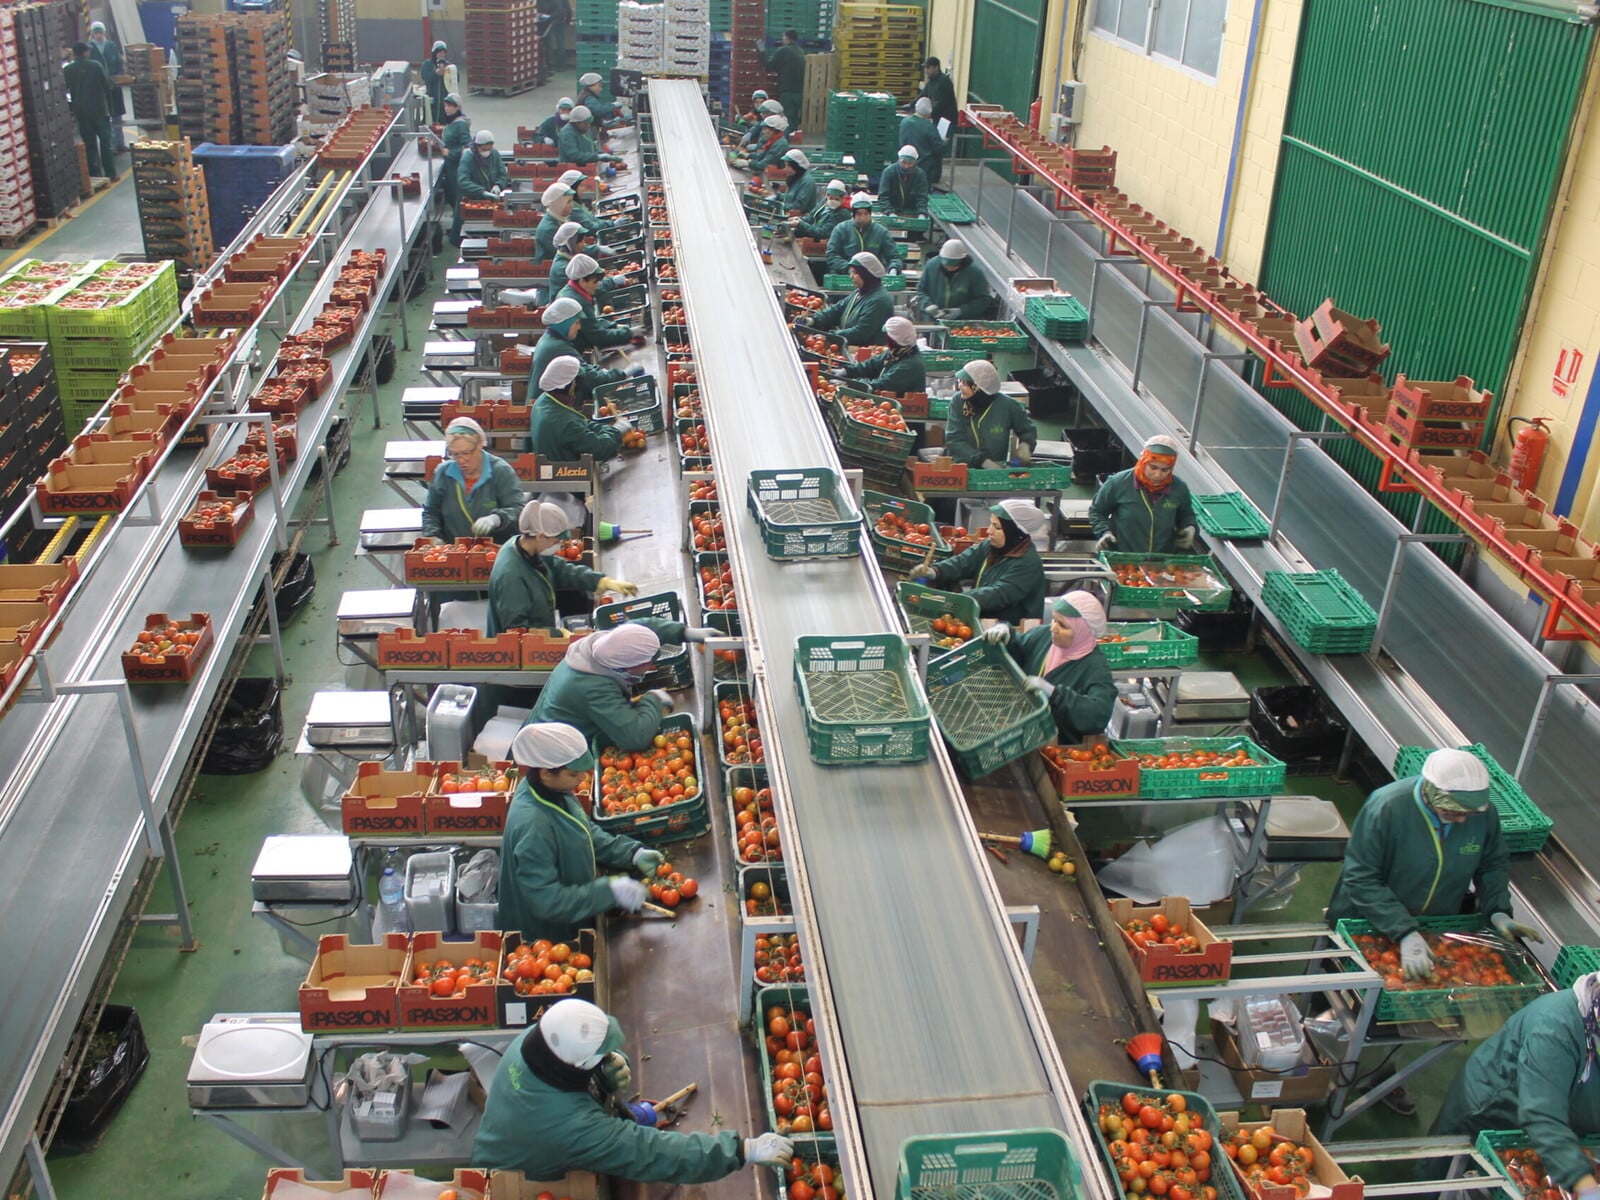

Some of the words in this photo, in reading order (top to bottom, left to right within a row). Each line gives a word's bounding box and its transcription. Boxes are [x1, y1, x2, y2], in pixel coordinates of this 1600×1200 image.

[555, 466, 588, 477] Alexia
[53, 493, 122, 510] PASSION
[387, 651, 442, 663] PASSION
[458, 651, 514, 664] PASSION
[531, 650, 567, 663] PASS
[1075, 777, 1133, 793] PASSION
[355, 816, 417, 830] PASSION
[438, 815, 501, 829] PASSION
[1156, 963, 1224, 979] PASSION
[314, 1010, 391, 1027] PASSION
[412, 1007, 488, 1024] PASSION
